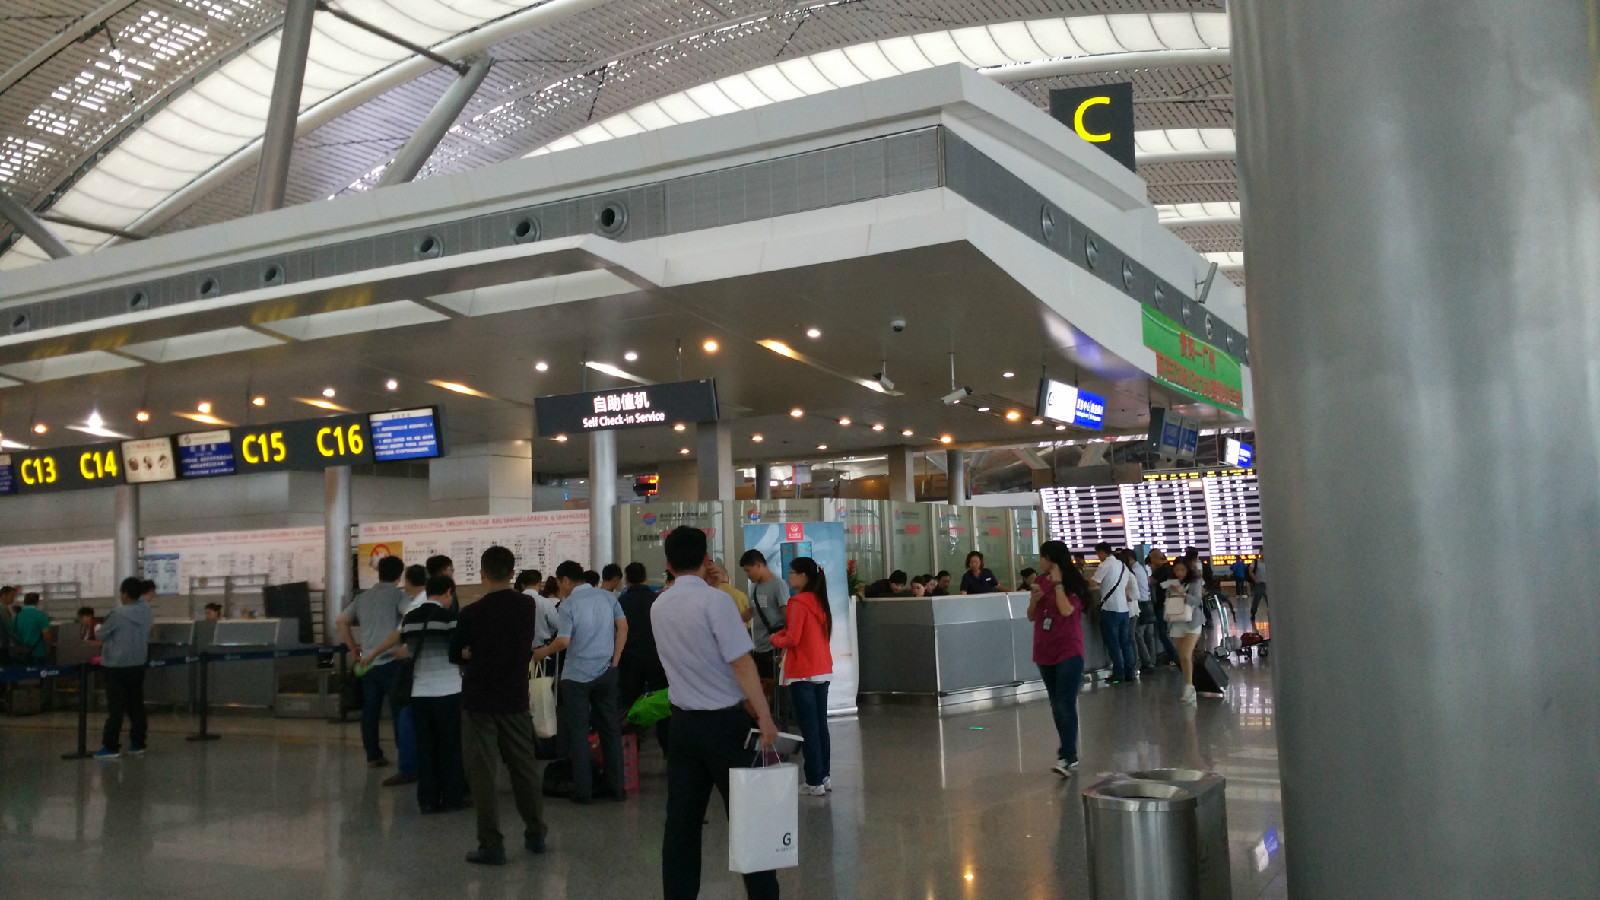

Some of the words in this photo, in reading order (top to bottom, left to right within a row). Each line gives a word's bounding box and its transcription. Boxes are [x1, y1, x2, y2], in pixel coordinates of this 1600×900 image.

[1074, 96, 1111, 142] C
[593, 391, 650, 414] 自助值机
[582, 416, 599, 428] Self
[599, 414, 634, 426] Check-in
[634, 410, 666, 423] Service
[242, 431, 286, 463] C15
[316, 424, 364, 457] C16
[21, 456, 57, 485] C13
[80, 449, 117, 479] C14
[782, 832, 792, 846] G
